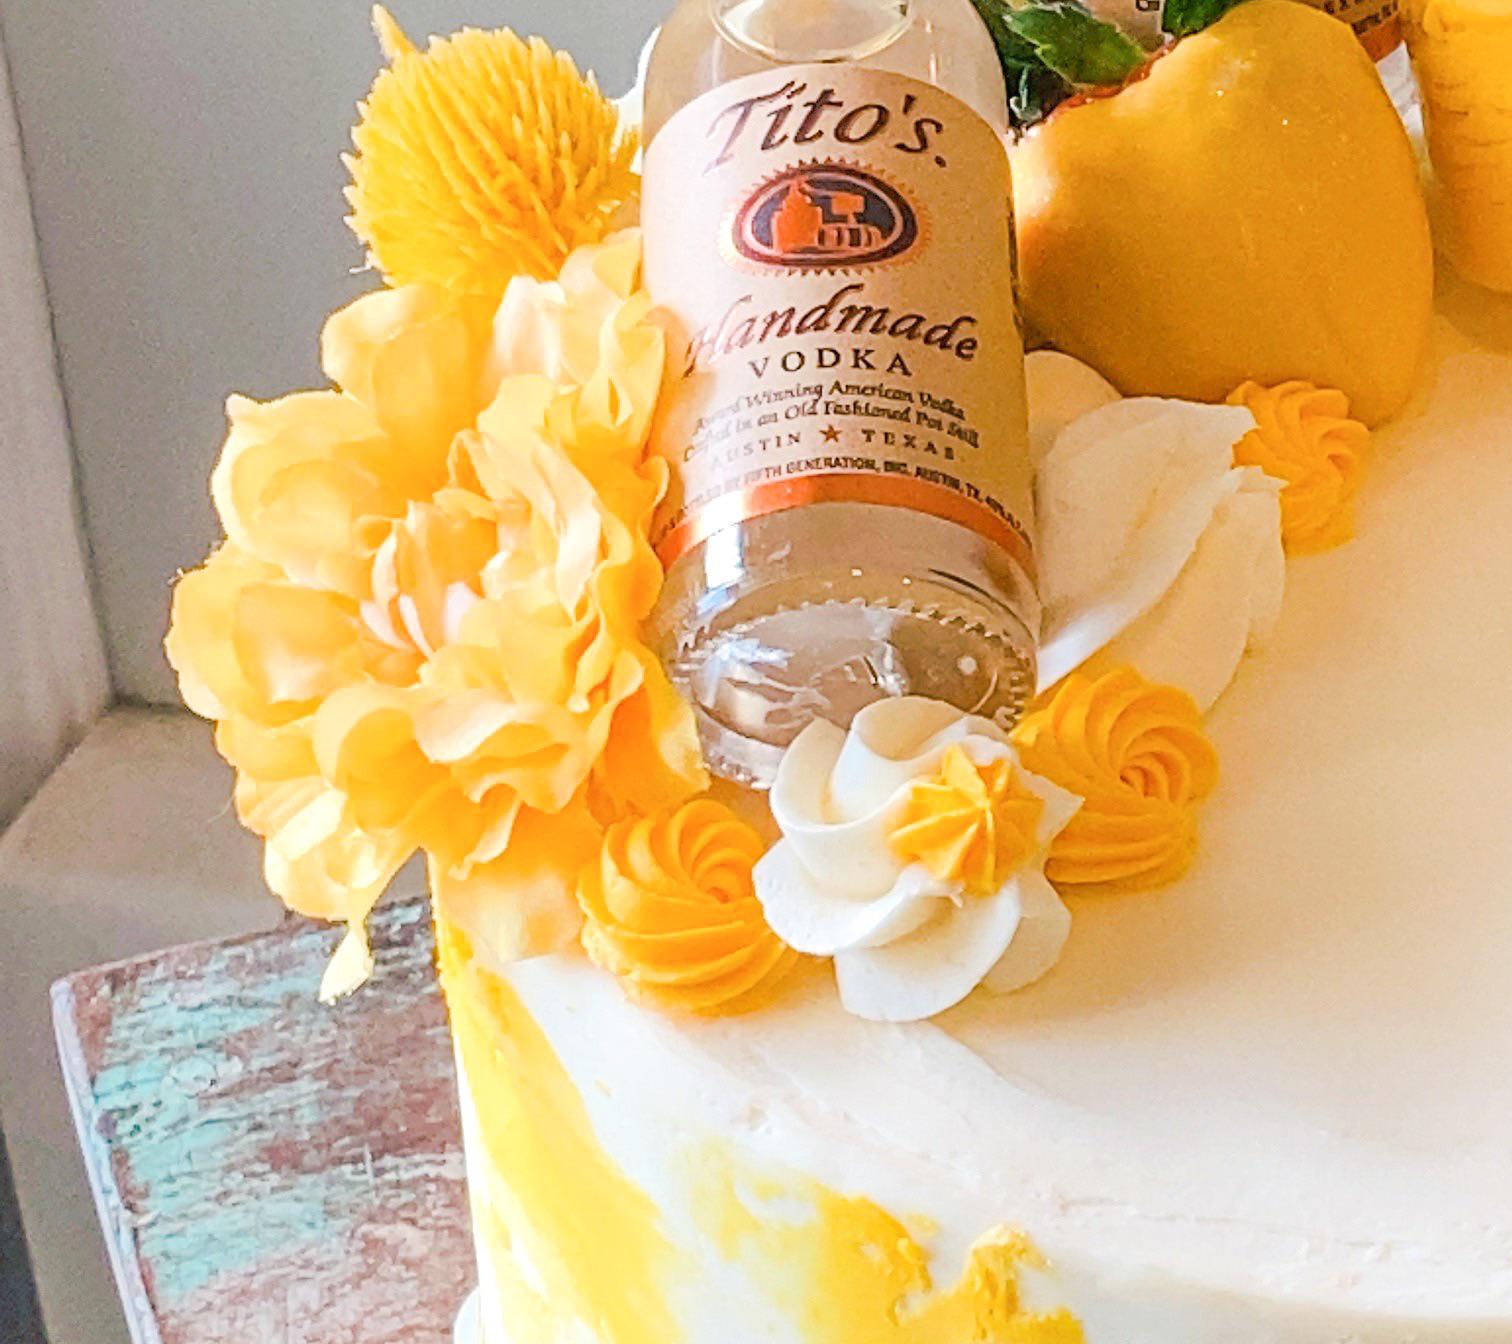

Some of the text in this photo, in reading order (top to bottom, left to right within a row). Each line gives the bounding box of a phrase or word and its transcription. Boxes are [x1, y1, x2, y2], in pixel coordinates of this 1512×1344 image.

[682, 284, 979, 379] Handmade
[749, 347, 913, 379] VODKA
[744, 380, 966, 422] Winning American Vodka
[784, 399, 818, 419] Old
[824, 400, 911, 424] Fashioned
[861, 428, 955, 461] TEXAS
[786, 456, 880, 474] GENERATION,
